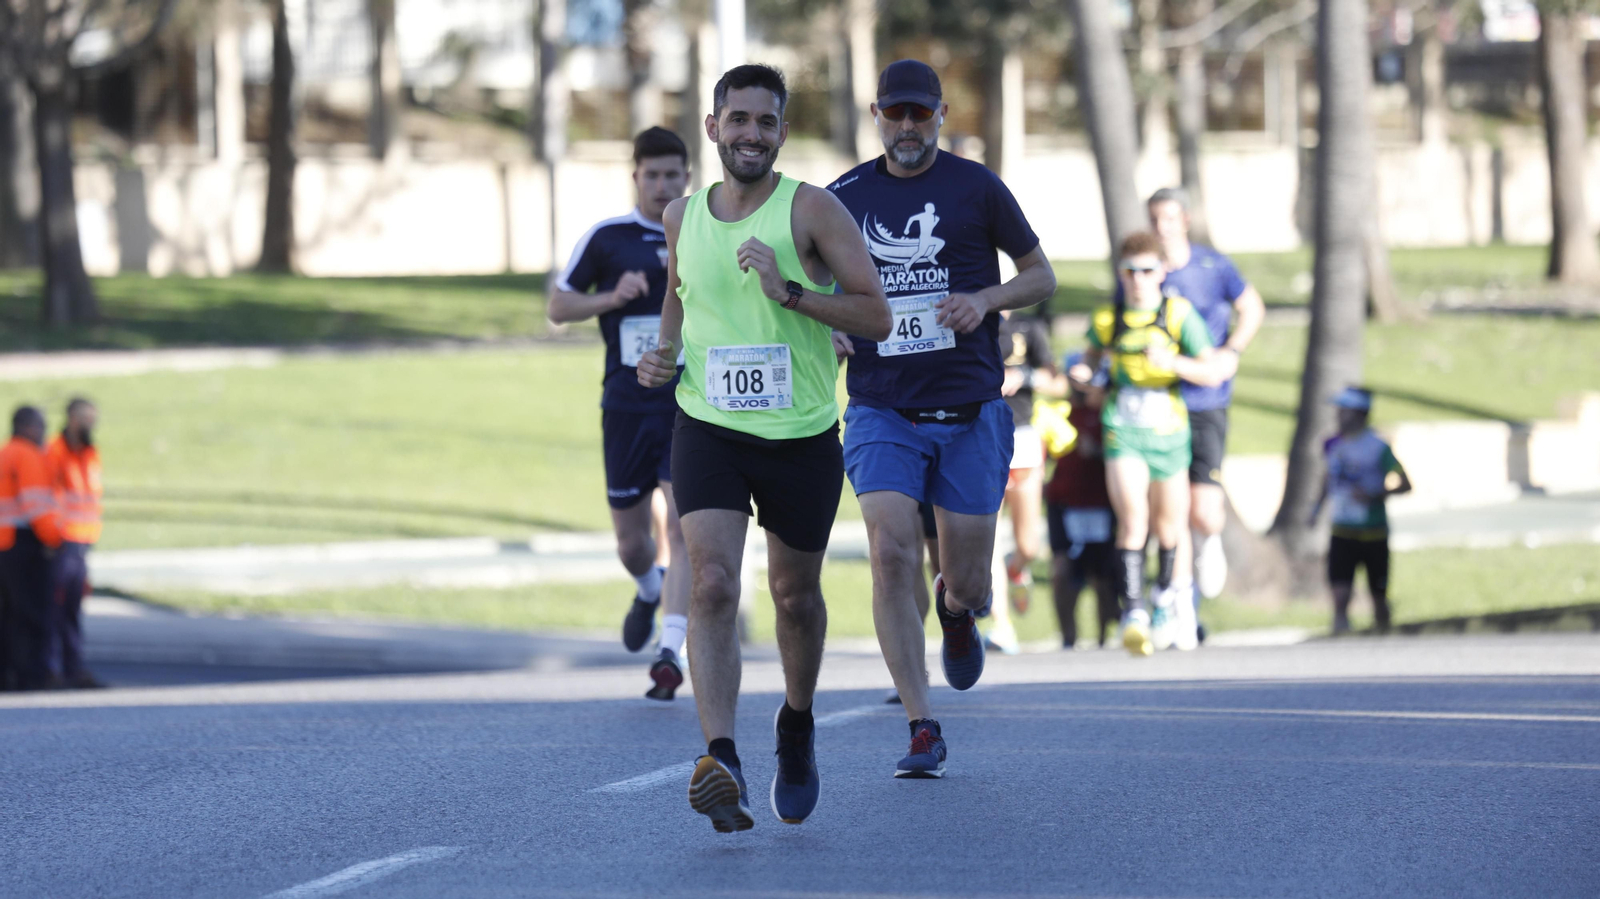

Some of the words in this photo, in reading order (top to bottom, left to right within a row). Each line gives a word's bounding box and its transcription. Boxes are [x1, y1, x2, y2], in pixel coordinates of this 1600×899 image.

[880, 265, 905, 273] MEDIA
[911, 282, 949, 291] ALGECIRAS
[896, 316, 923, 340] 46
[897, 341, 936, 353] EVOS
[722, 369, 764, 395] 108
[727, 399, 770, 409] EVOS
